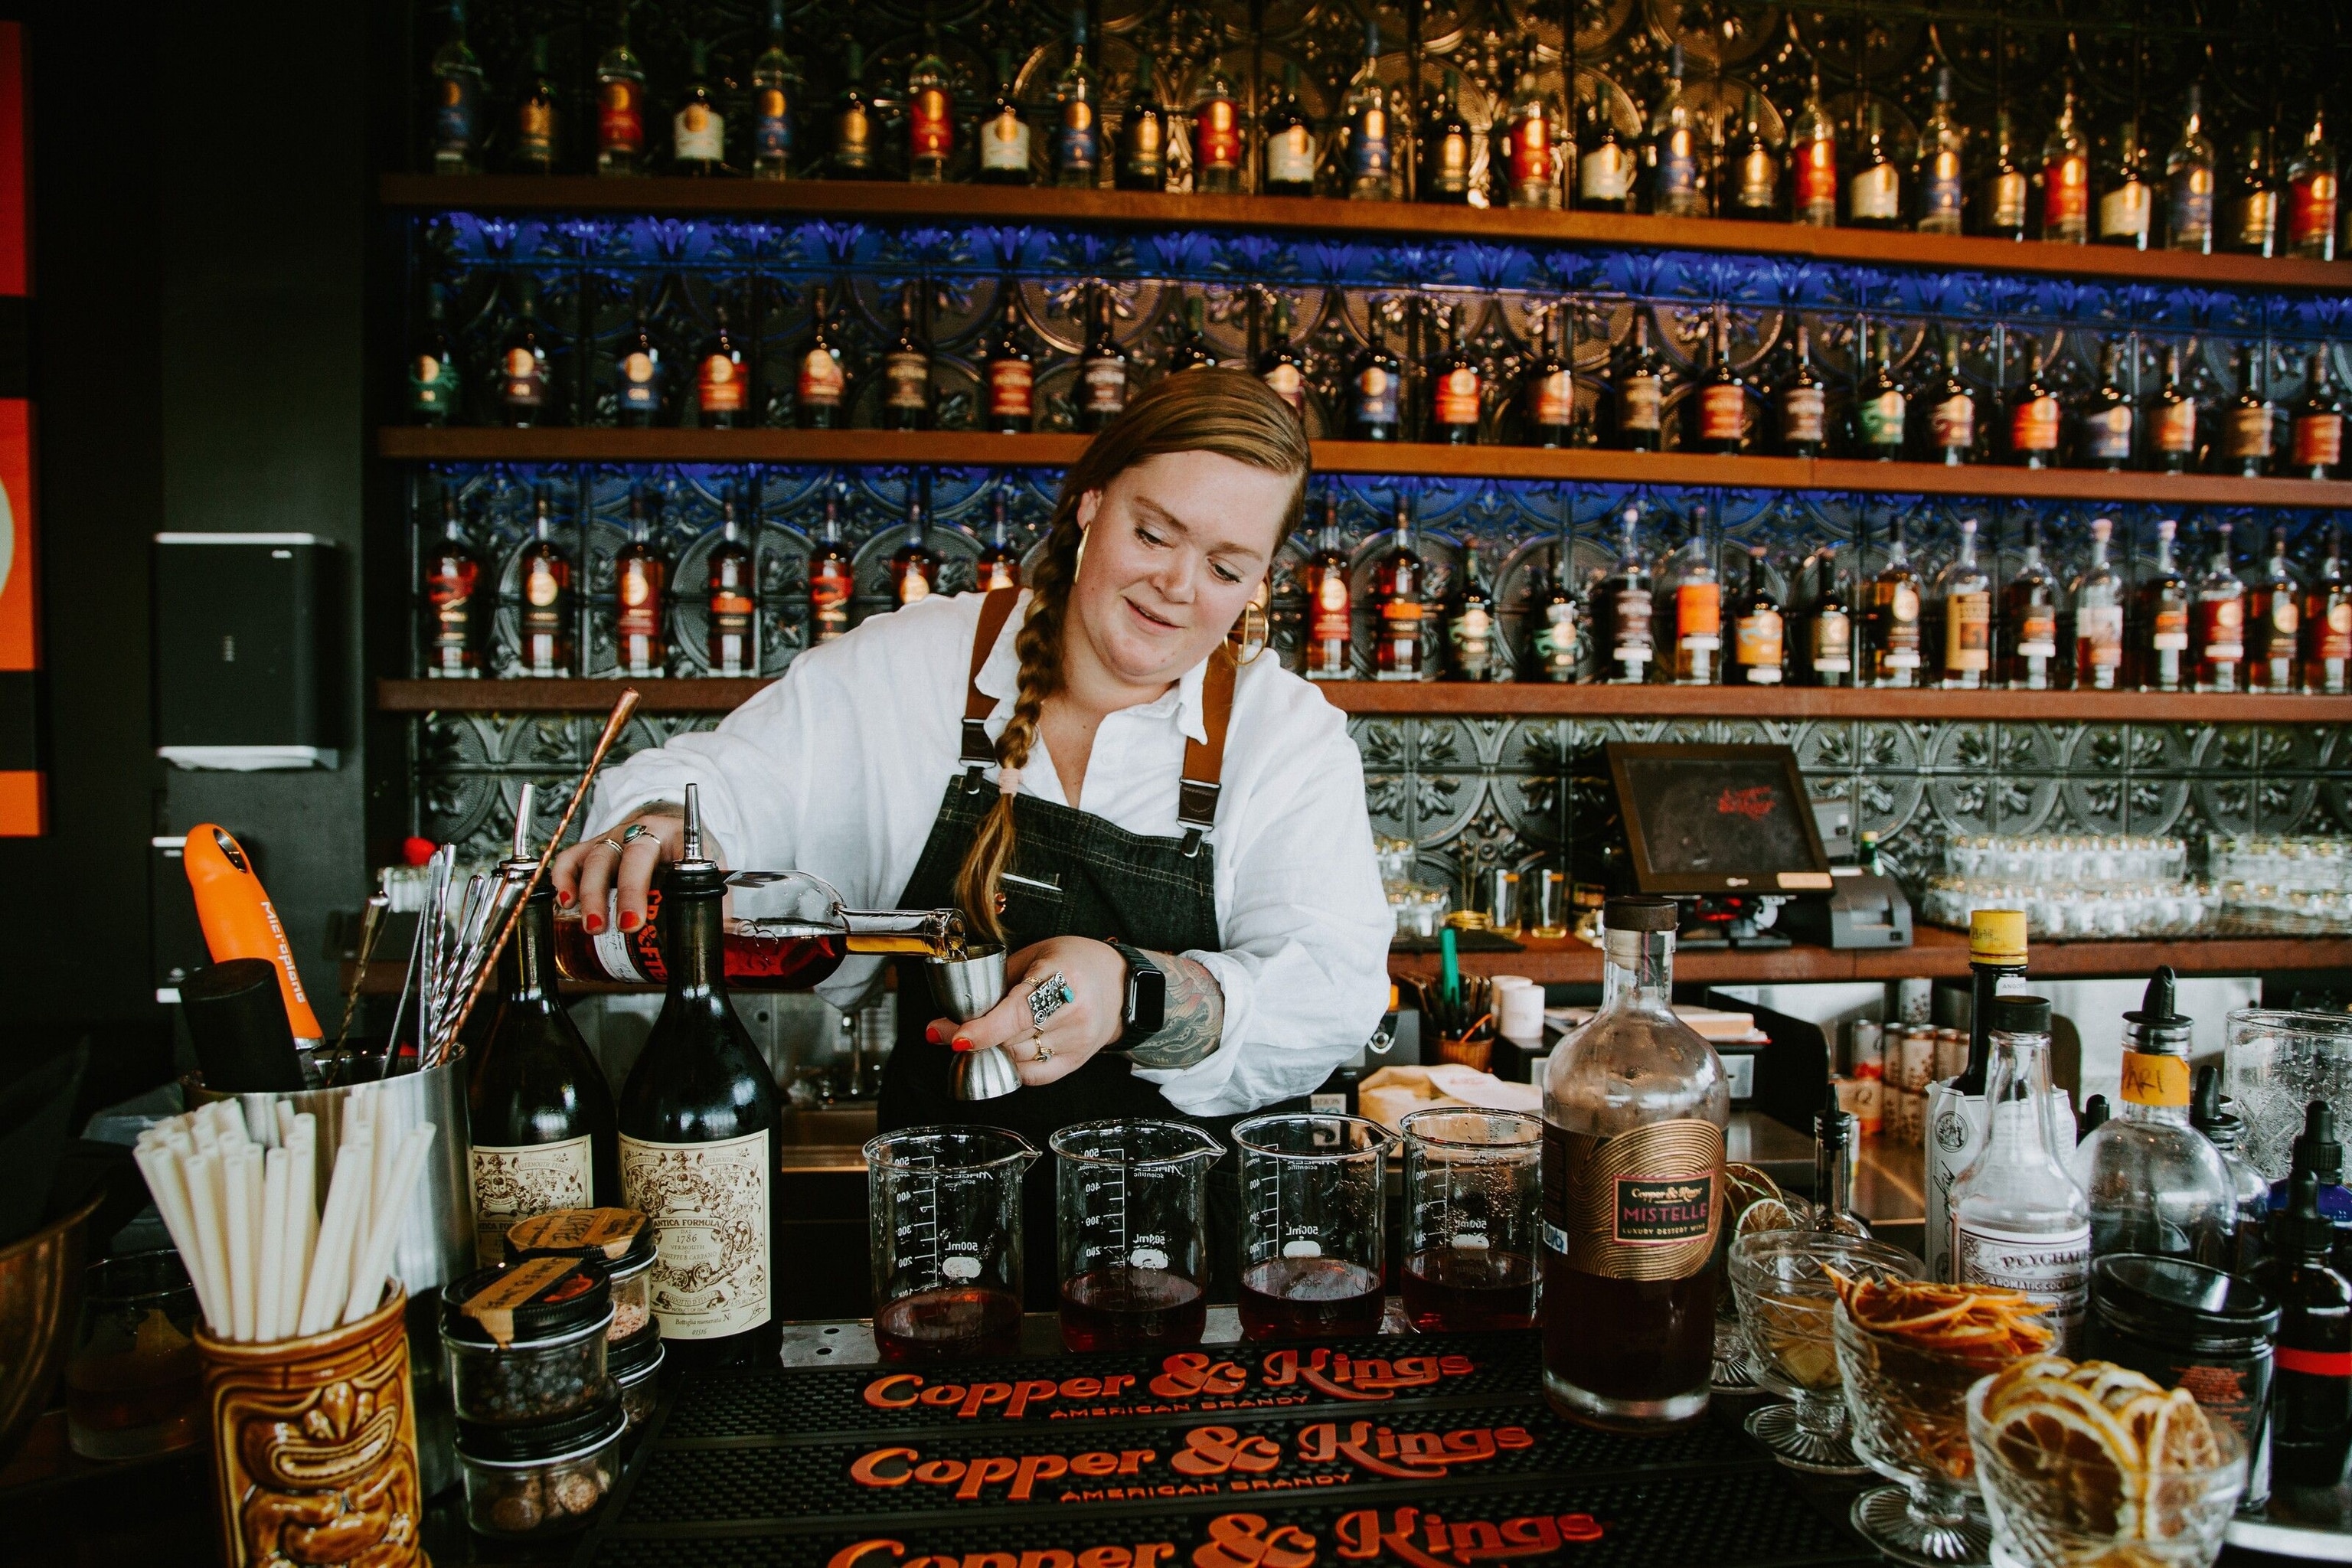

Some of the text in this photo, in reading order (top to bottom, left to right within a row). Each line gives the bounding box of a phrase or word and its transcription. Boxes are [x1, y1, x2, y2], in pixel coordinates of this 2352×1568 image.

[653, 1218, 720, 1227] ANTICA FORMULA
[1623, 1202, 1708, 1223] MISTELLE
[676, 1234, 697, 1244] 1786
[864, 1348, 1475, 1418] Copper & Kings
[1050, 1395, 1308, 1419] AMERICAN BRANDY
[851, 1420, 1534, 1501] Copper & Kings
[1060, 1473, 1351, 1503] AMERICAN BRANDY
[1192, 1514, 1317, 1568] &
[1336, 1507, 1604, 1568] Kings
